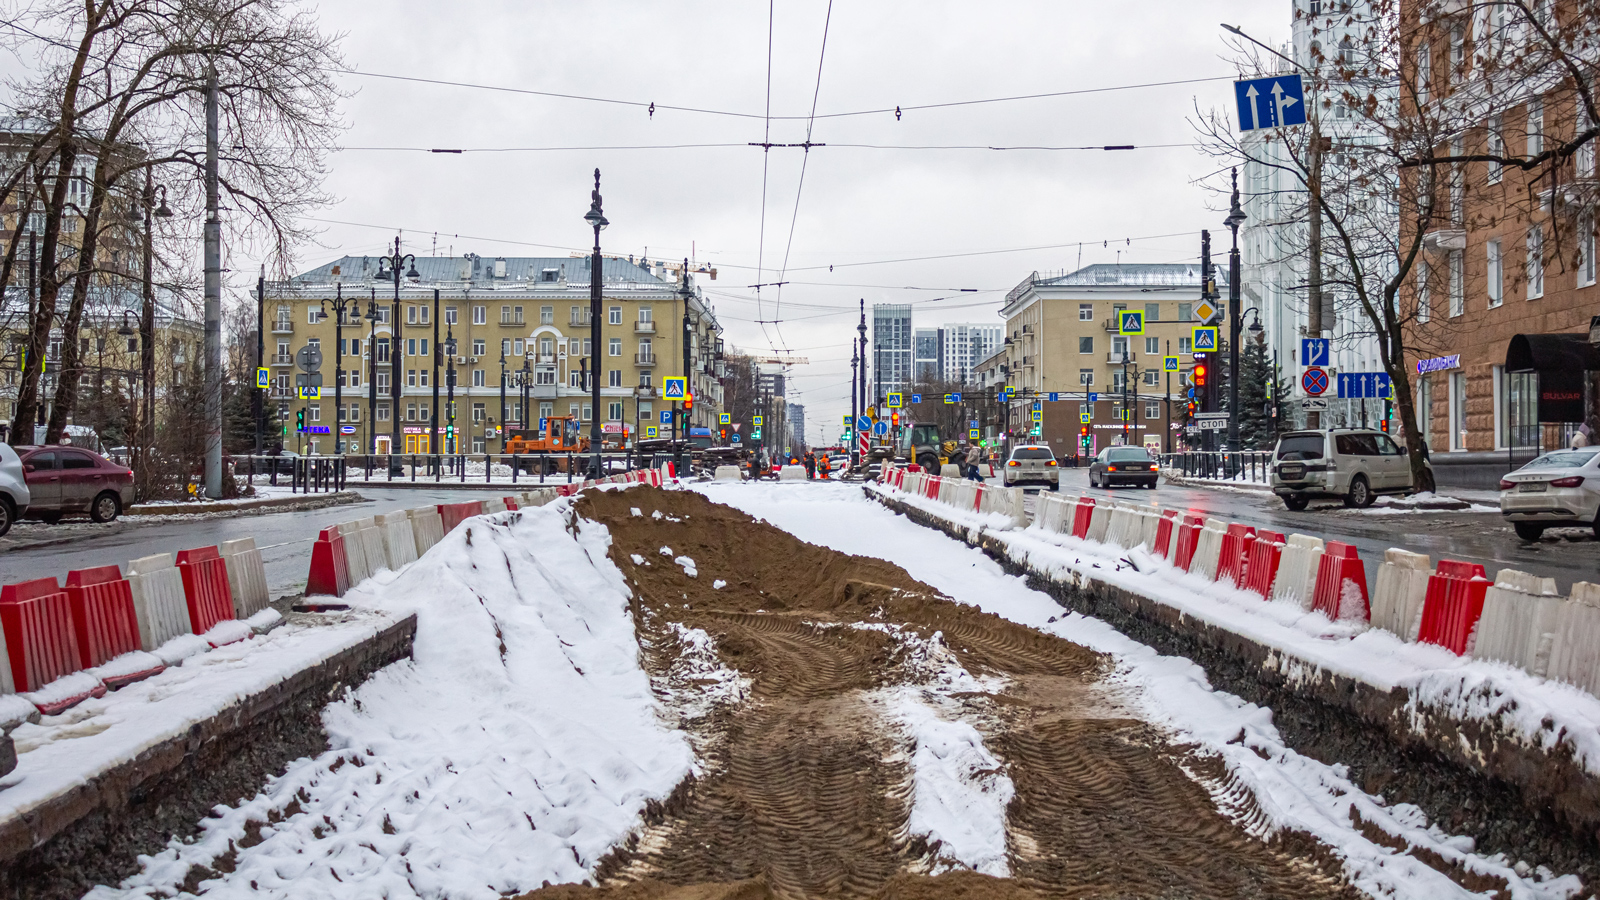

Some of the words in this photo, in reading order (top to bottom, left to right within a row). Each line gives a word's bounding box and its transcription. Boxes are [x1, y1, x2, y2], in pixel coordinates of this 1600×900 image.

[1543, 392, 1580, 400] BULVAR
[1201, 420, 1224, 429] СТОП
[297, 426, 331, 434] ПТЕКА
